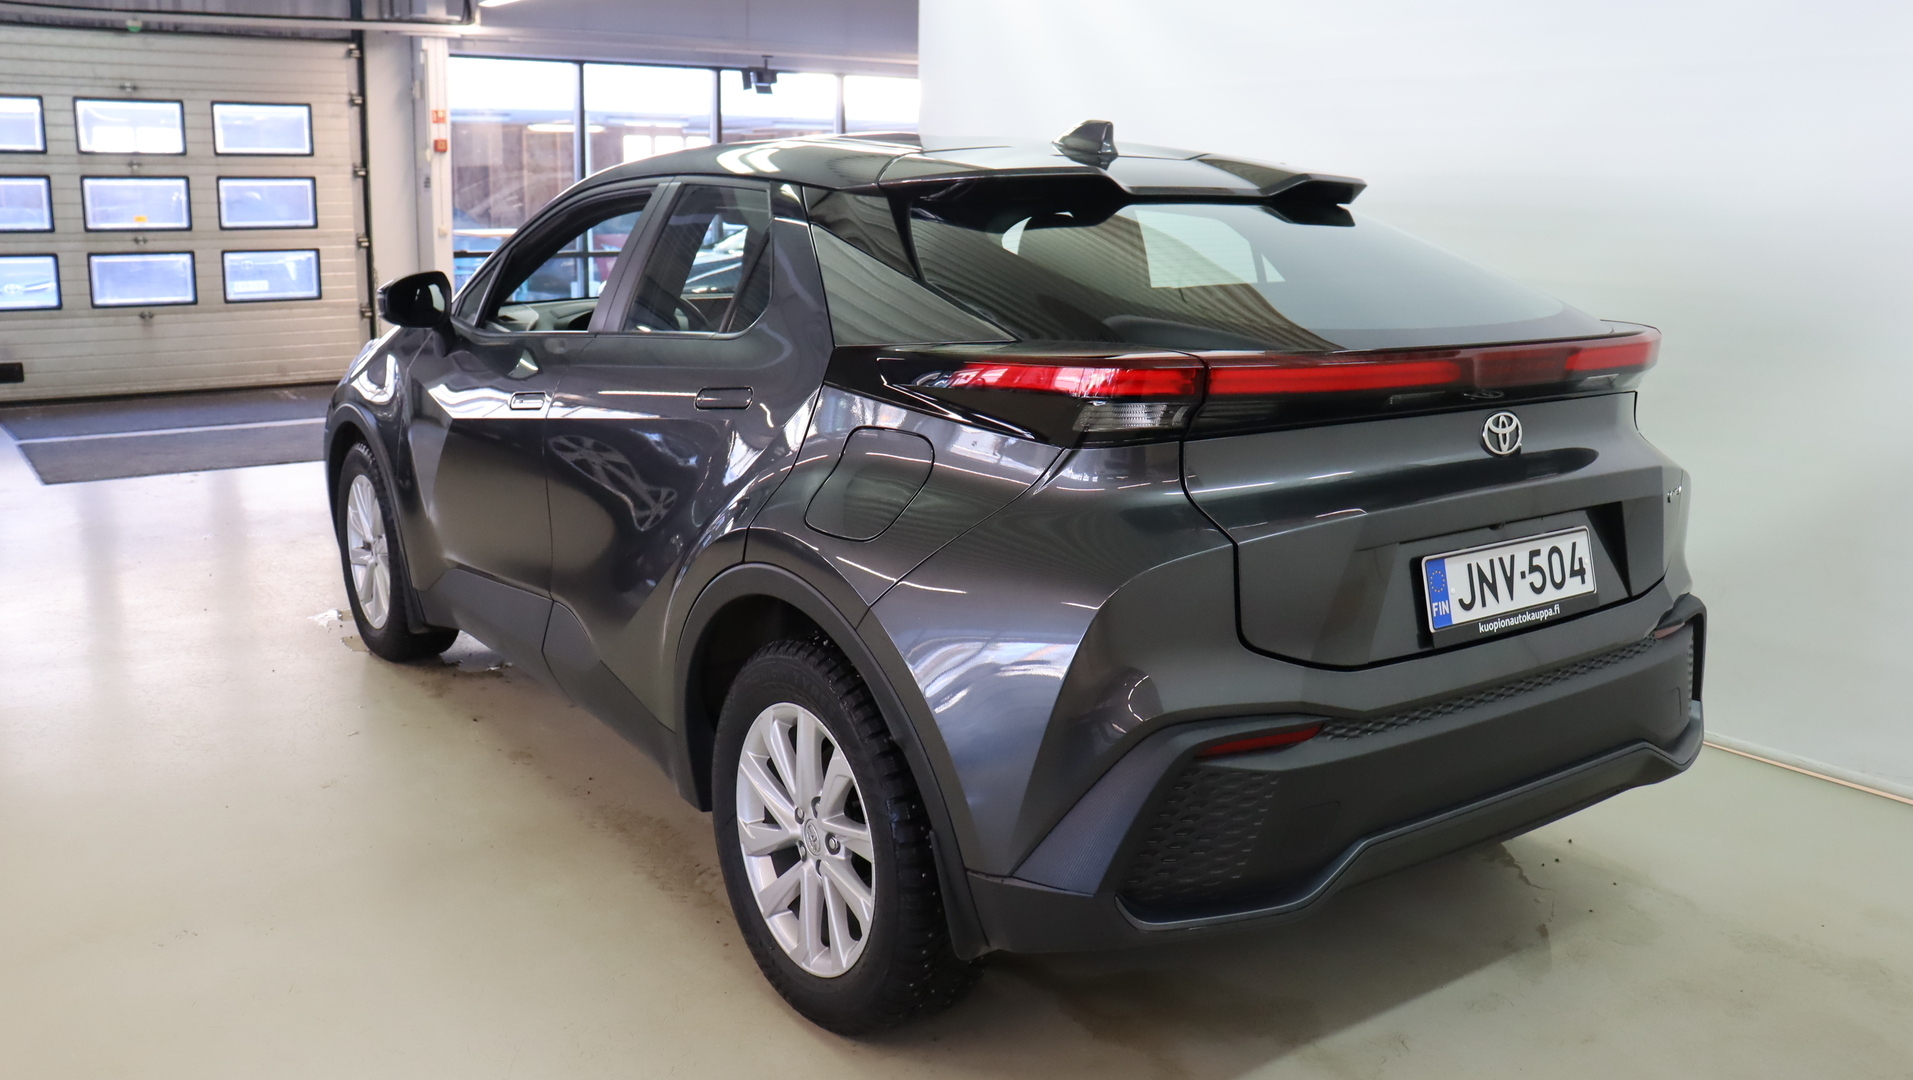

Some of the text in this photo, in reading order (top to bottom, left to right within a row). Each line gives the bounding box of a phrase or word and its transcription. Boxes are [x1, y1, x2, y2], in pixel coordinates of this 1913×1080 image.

[1458, 541, 1586, 612] JNV-504
[1432, 600, 1450, 617] FIN
[1479, 604, 1560, 634] kuopionautokauppa.fi
